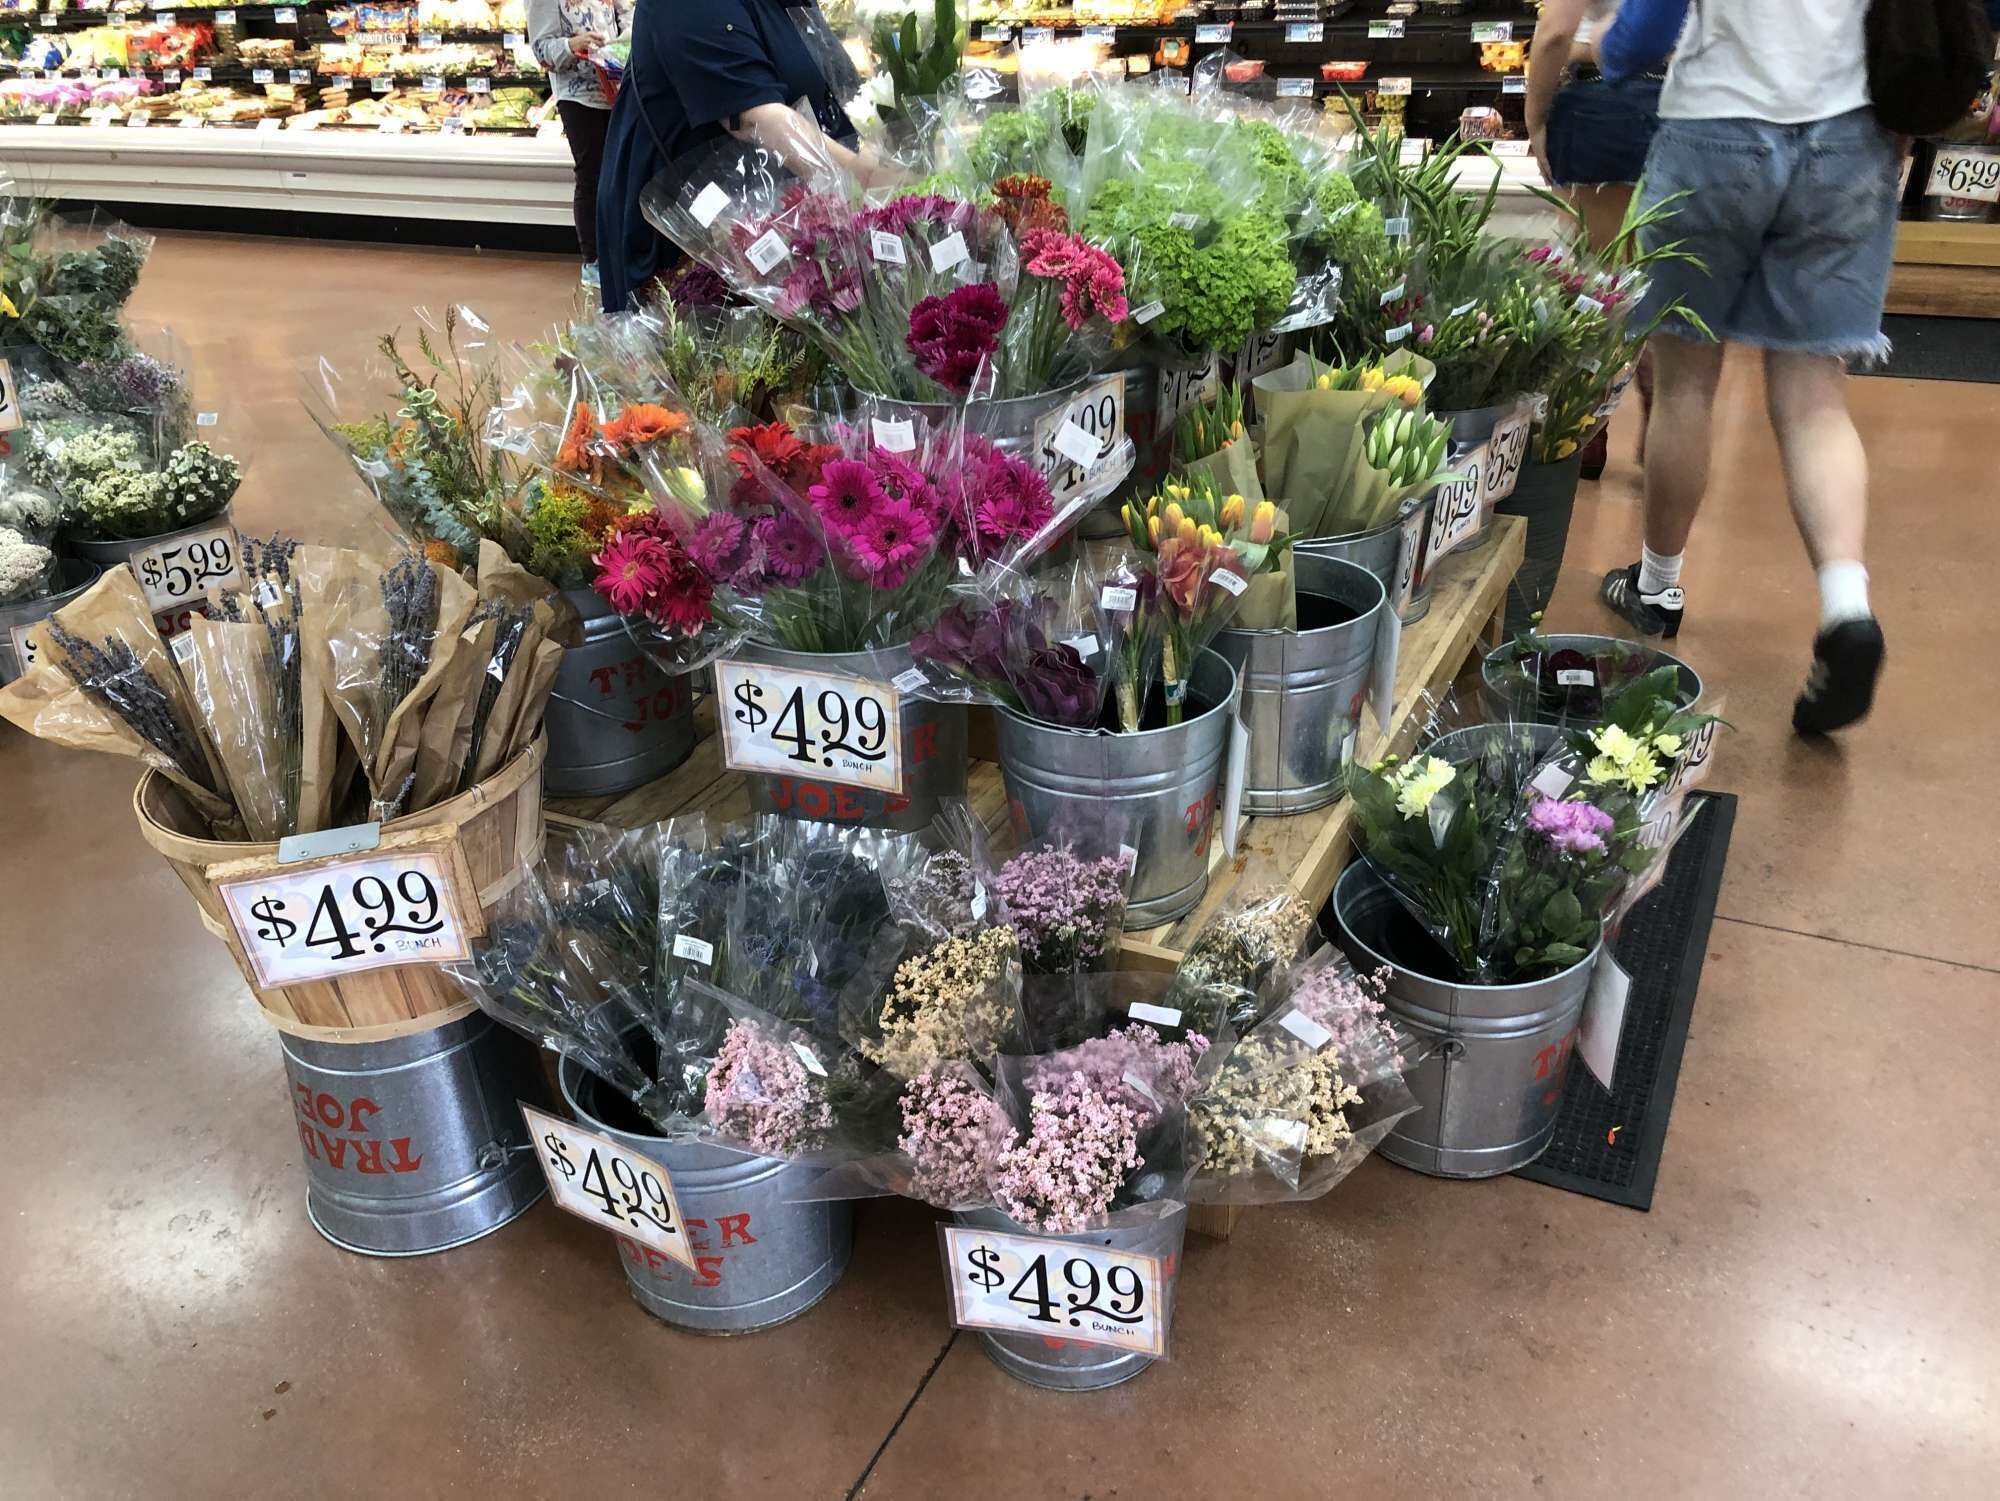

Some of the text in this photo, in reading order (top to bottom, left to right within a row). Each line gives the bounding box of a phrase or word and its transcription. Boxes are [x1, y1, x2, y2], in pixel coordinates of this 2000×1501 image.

[1936, 157, 2000, 193] $6.99
[141, 537, 235, 597] $5.99
[733, 678, 887, 768] $4.99
[841, 758, 873, 773] BUNCH
[249, 869, 444, 961] $4.99
[543, 1131, 676, 1234] $4.99
[967, 1244, 1145, 1327] $4.99
[1091, 1321, 1135, 1336] BUNCH
